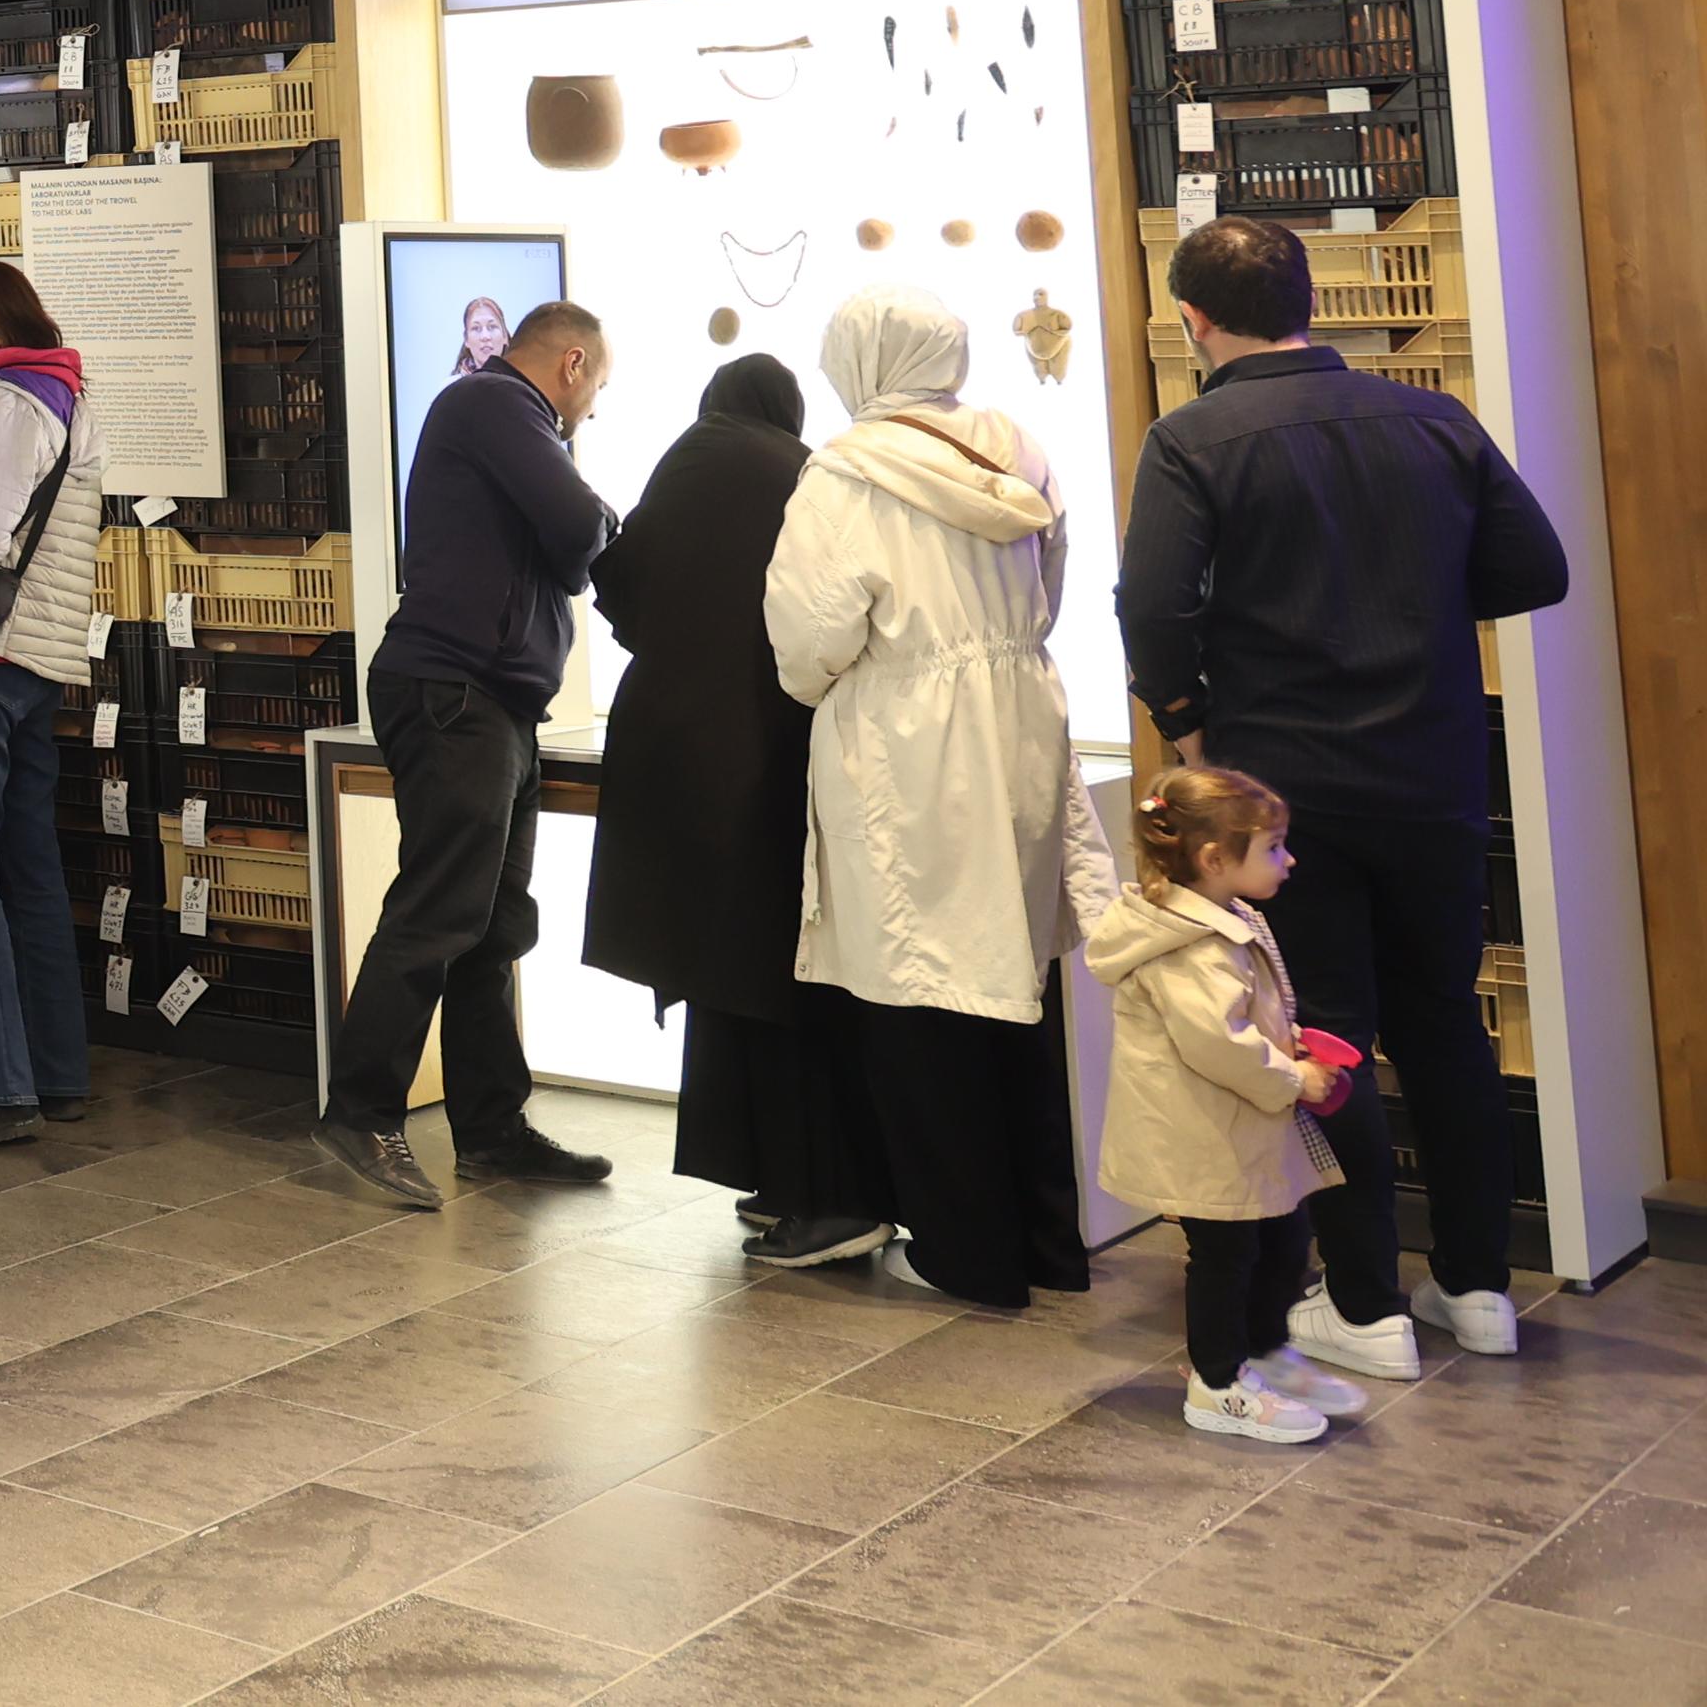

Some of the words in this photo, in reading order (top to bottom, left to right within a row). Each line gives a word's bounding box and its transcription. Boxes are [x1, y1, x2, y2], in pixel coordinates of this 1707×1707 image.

[1179, 4, 1203, 16] CB
[62, 52, 77, 62] CB
[31, 181, 63, 190] MALANIN
[64, 180, 97, 188] UCUNDAN
[32, 199, 51, 207] FROM
[66, 198, 83, 206] EDGE
[85, 197, 94, 205] OF
[96, 197, 108, 205] THE
[110, 196, 138, 204] TROWEL
[32, 209, 41, 217] TO
[43, 208, 55, 216] THE
